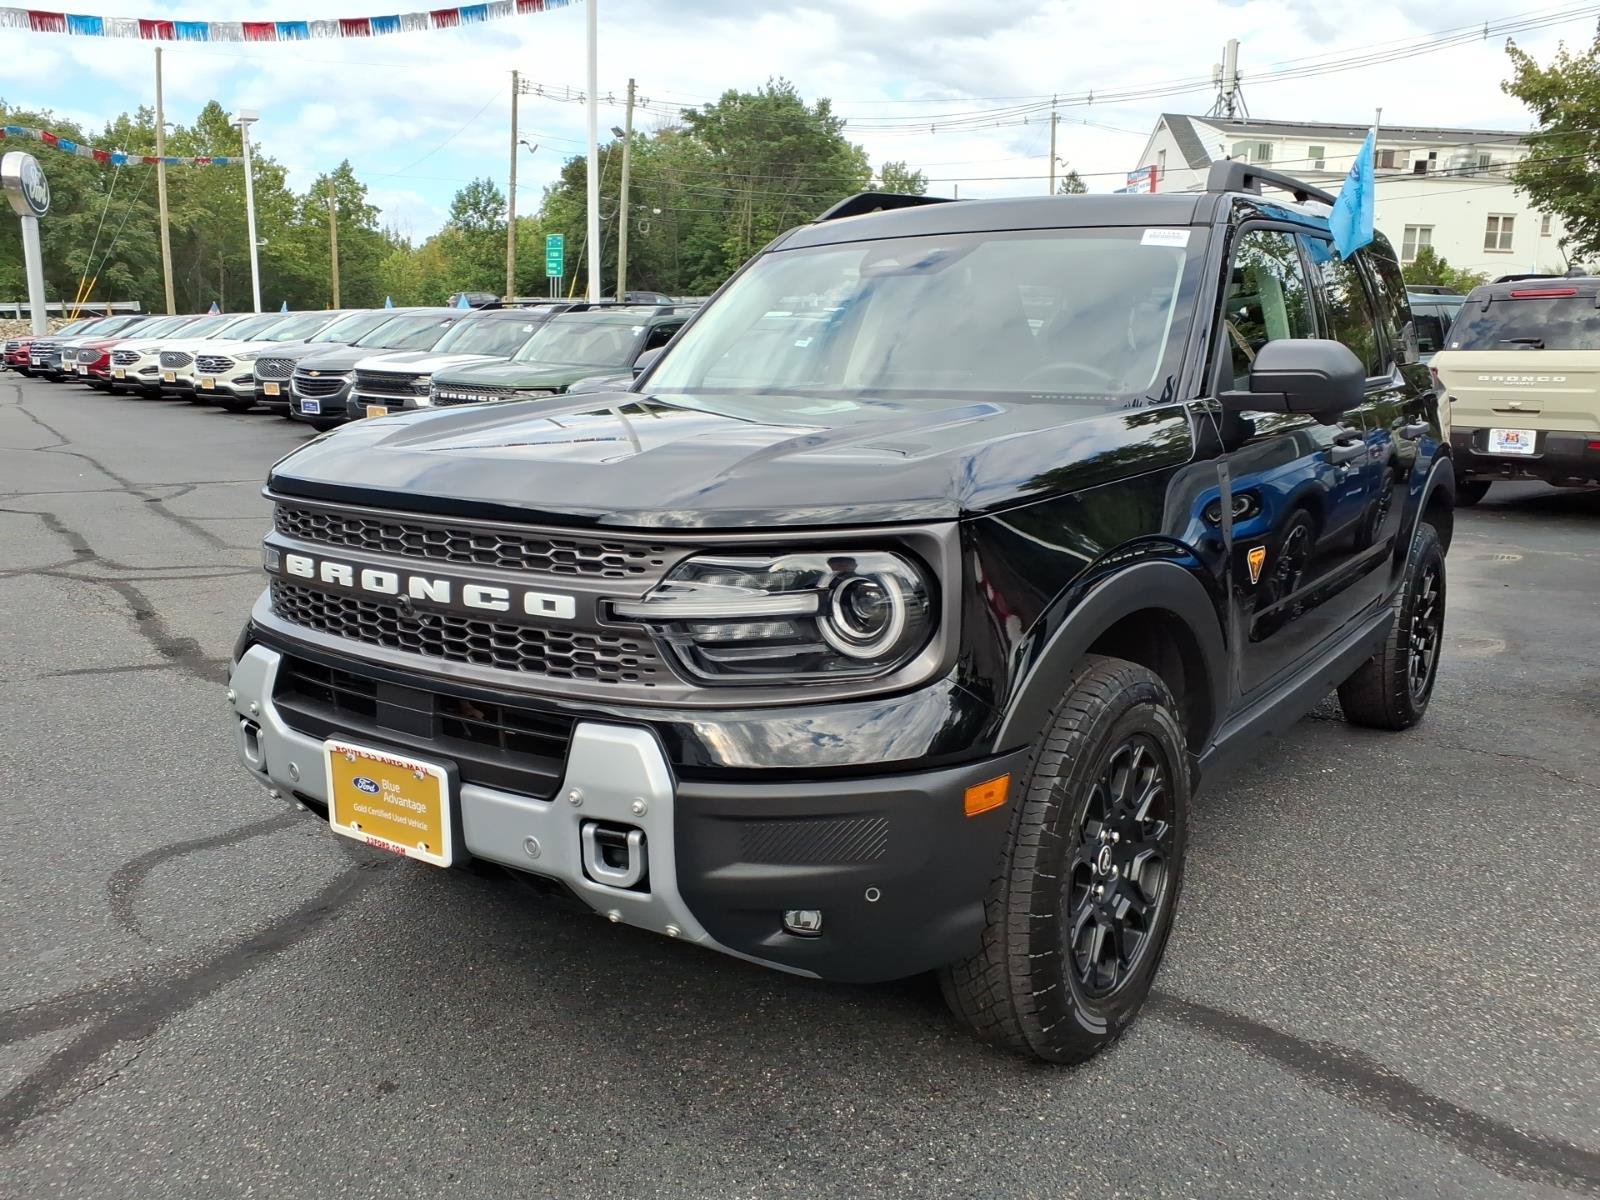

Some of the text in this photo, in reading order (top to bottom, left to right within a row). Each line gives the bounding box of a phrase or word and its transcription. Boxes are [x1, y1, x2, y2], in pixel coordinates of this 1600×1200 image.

[440, 392, 499, 402] BRONCO
[286, 553, 576, 620] BRONCO
[380, 757, 403, 767] AUTO
[356, 777, 377, 793] Ford
[381, 779, 401, 793] Blue
[383, 791, 427, 813] Advantage
[353, 803, 429, 831] Gold Certified Used Vehicle
